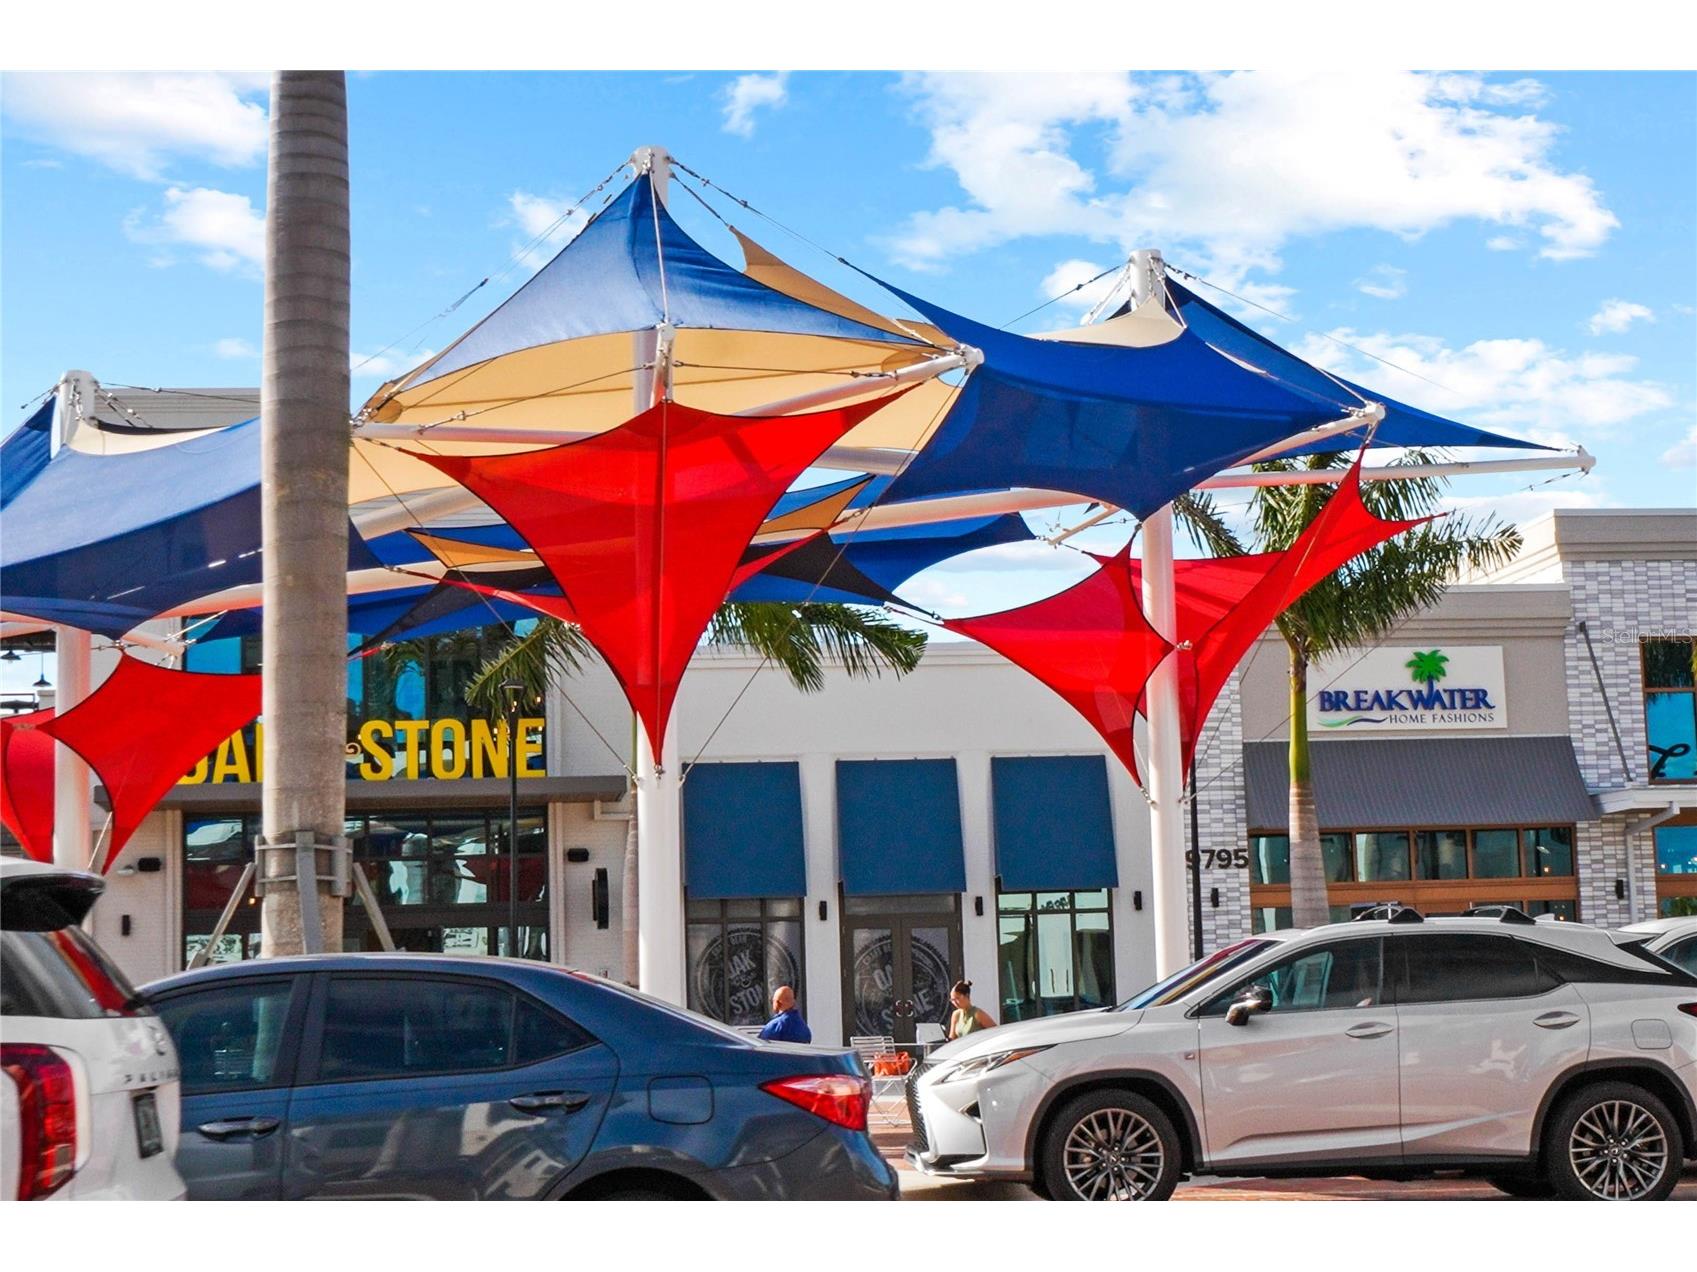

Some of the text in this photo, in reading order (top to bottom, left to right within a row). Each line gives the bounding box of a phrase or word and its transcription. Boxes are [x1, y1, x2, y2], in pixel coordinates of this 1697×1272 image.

[1319, 688, 1496, 712] BREAKWATER
[1389, 712, 1495, 725] HOME FASHIONS
[360, 718, 546, 781] STONE
[1185, 848, 1249, 869] 9795
